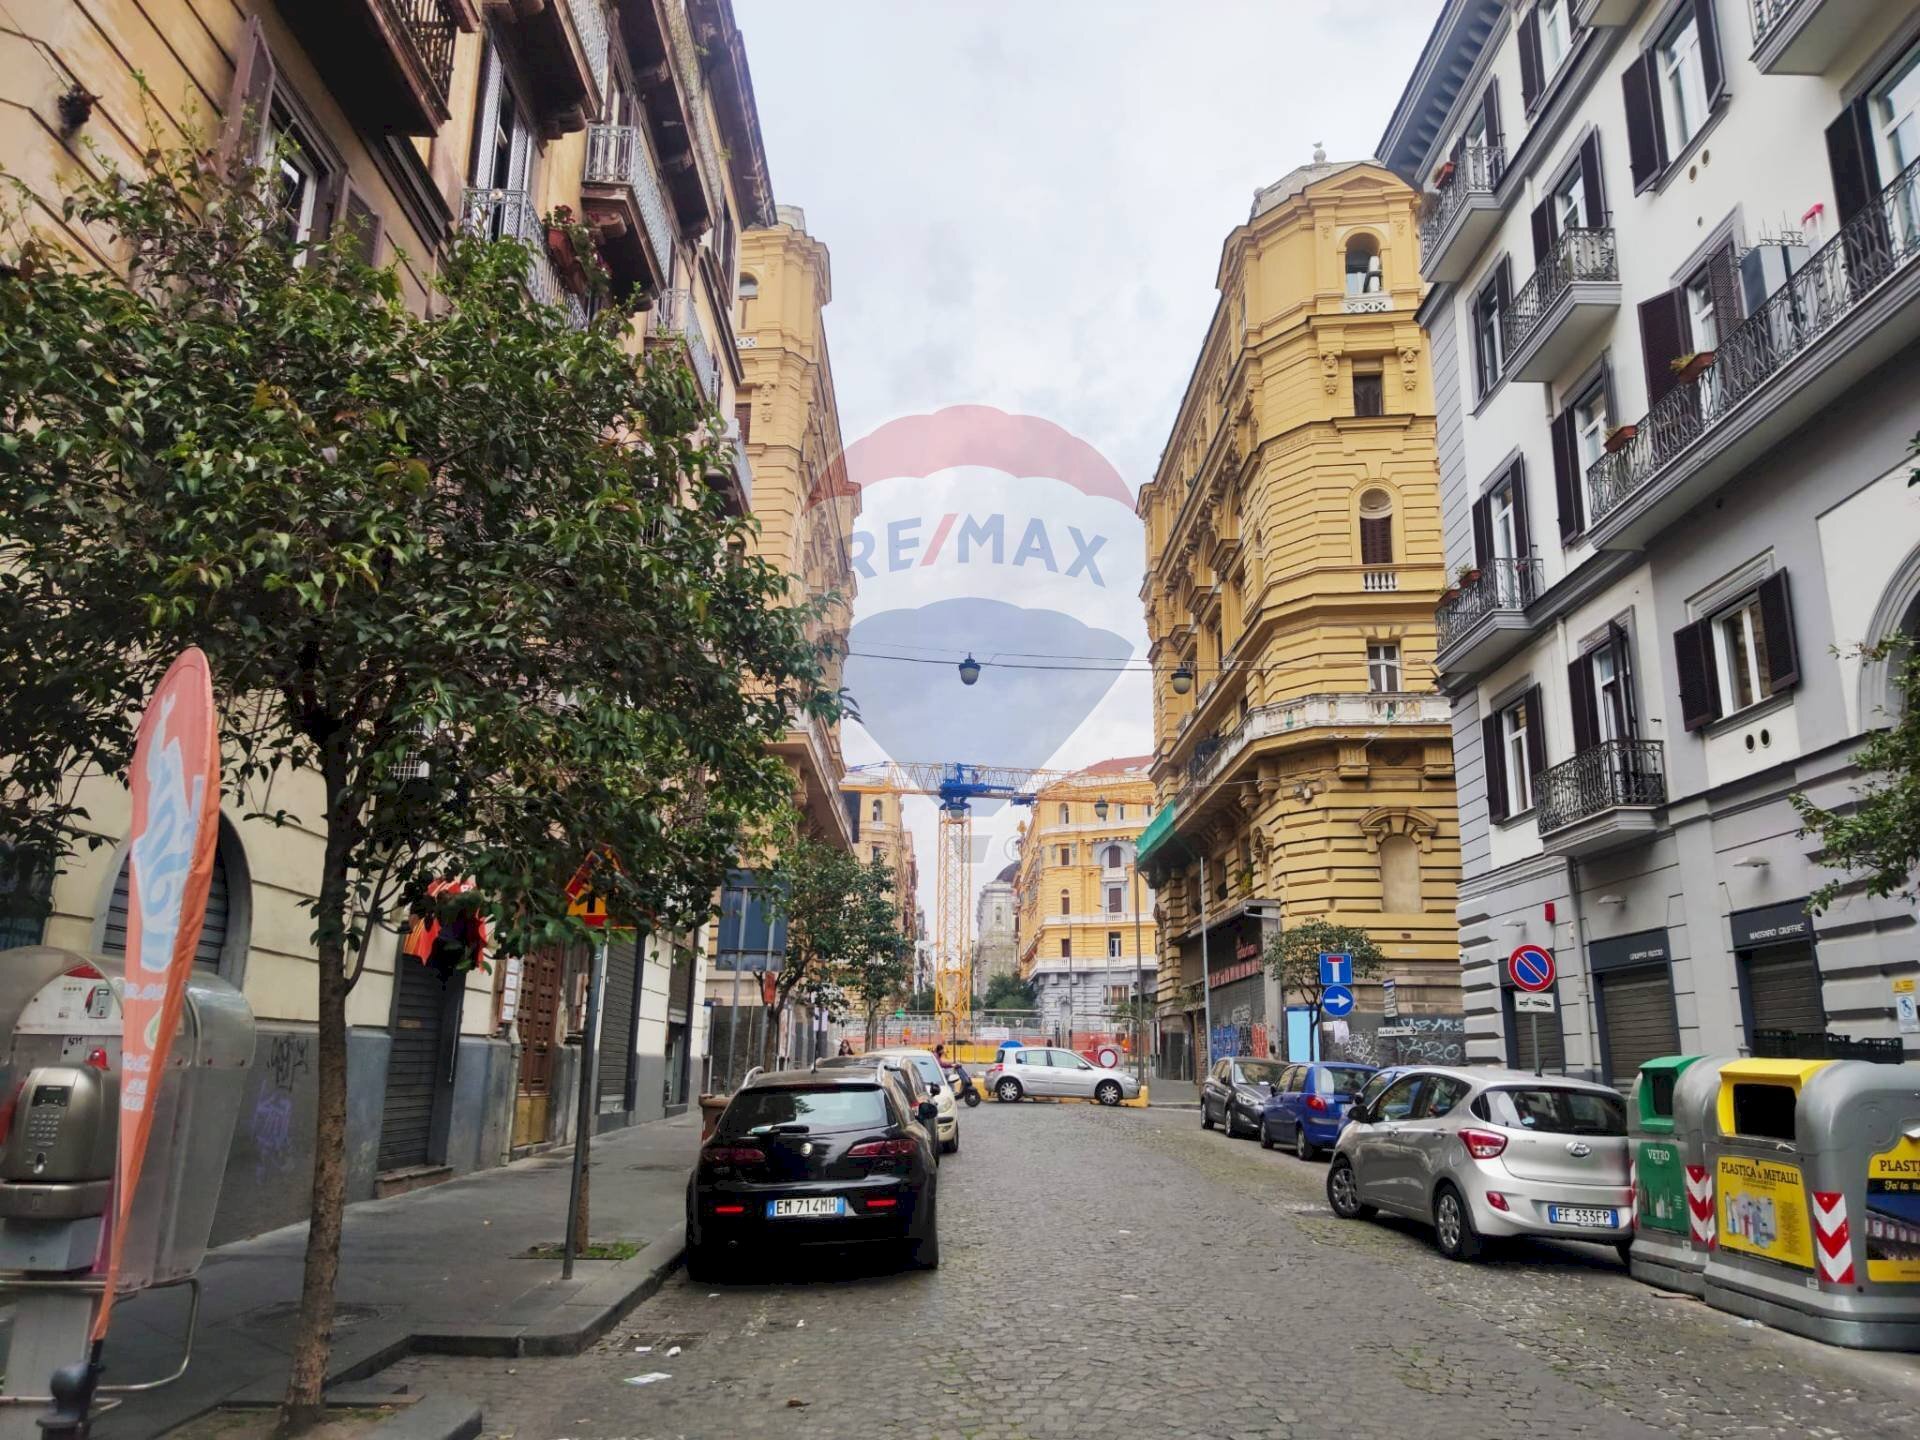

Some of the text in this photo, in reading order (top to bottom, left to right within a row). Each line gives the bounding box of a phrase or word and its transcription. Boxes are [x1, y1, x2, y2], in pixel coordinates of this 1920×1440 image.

[1647, 1149, 1670, 1161] VETRO
[1721, 1162, 1756, 1178] PLASTICA
[1763, 1168, 1798, 1185] METALLI
[776, 1200, 792, 1215] EM
[1557, 1208, 1610, 1223] FF 333FP
